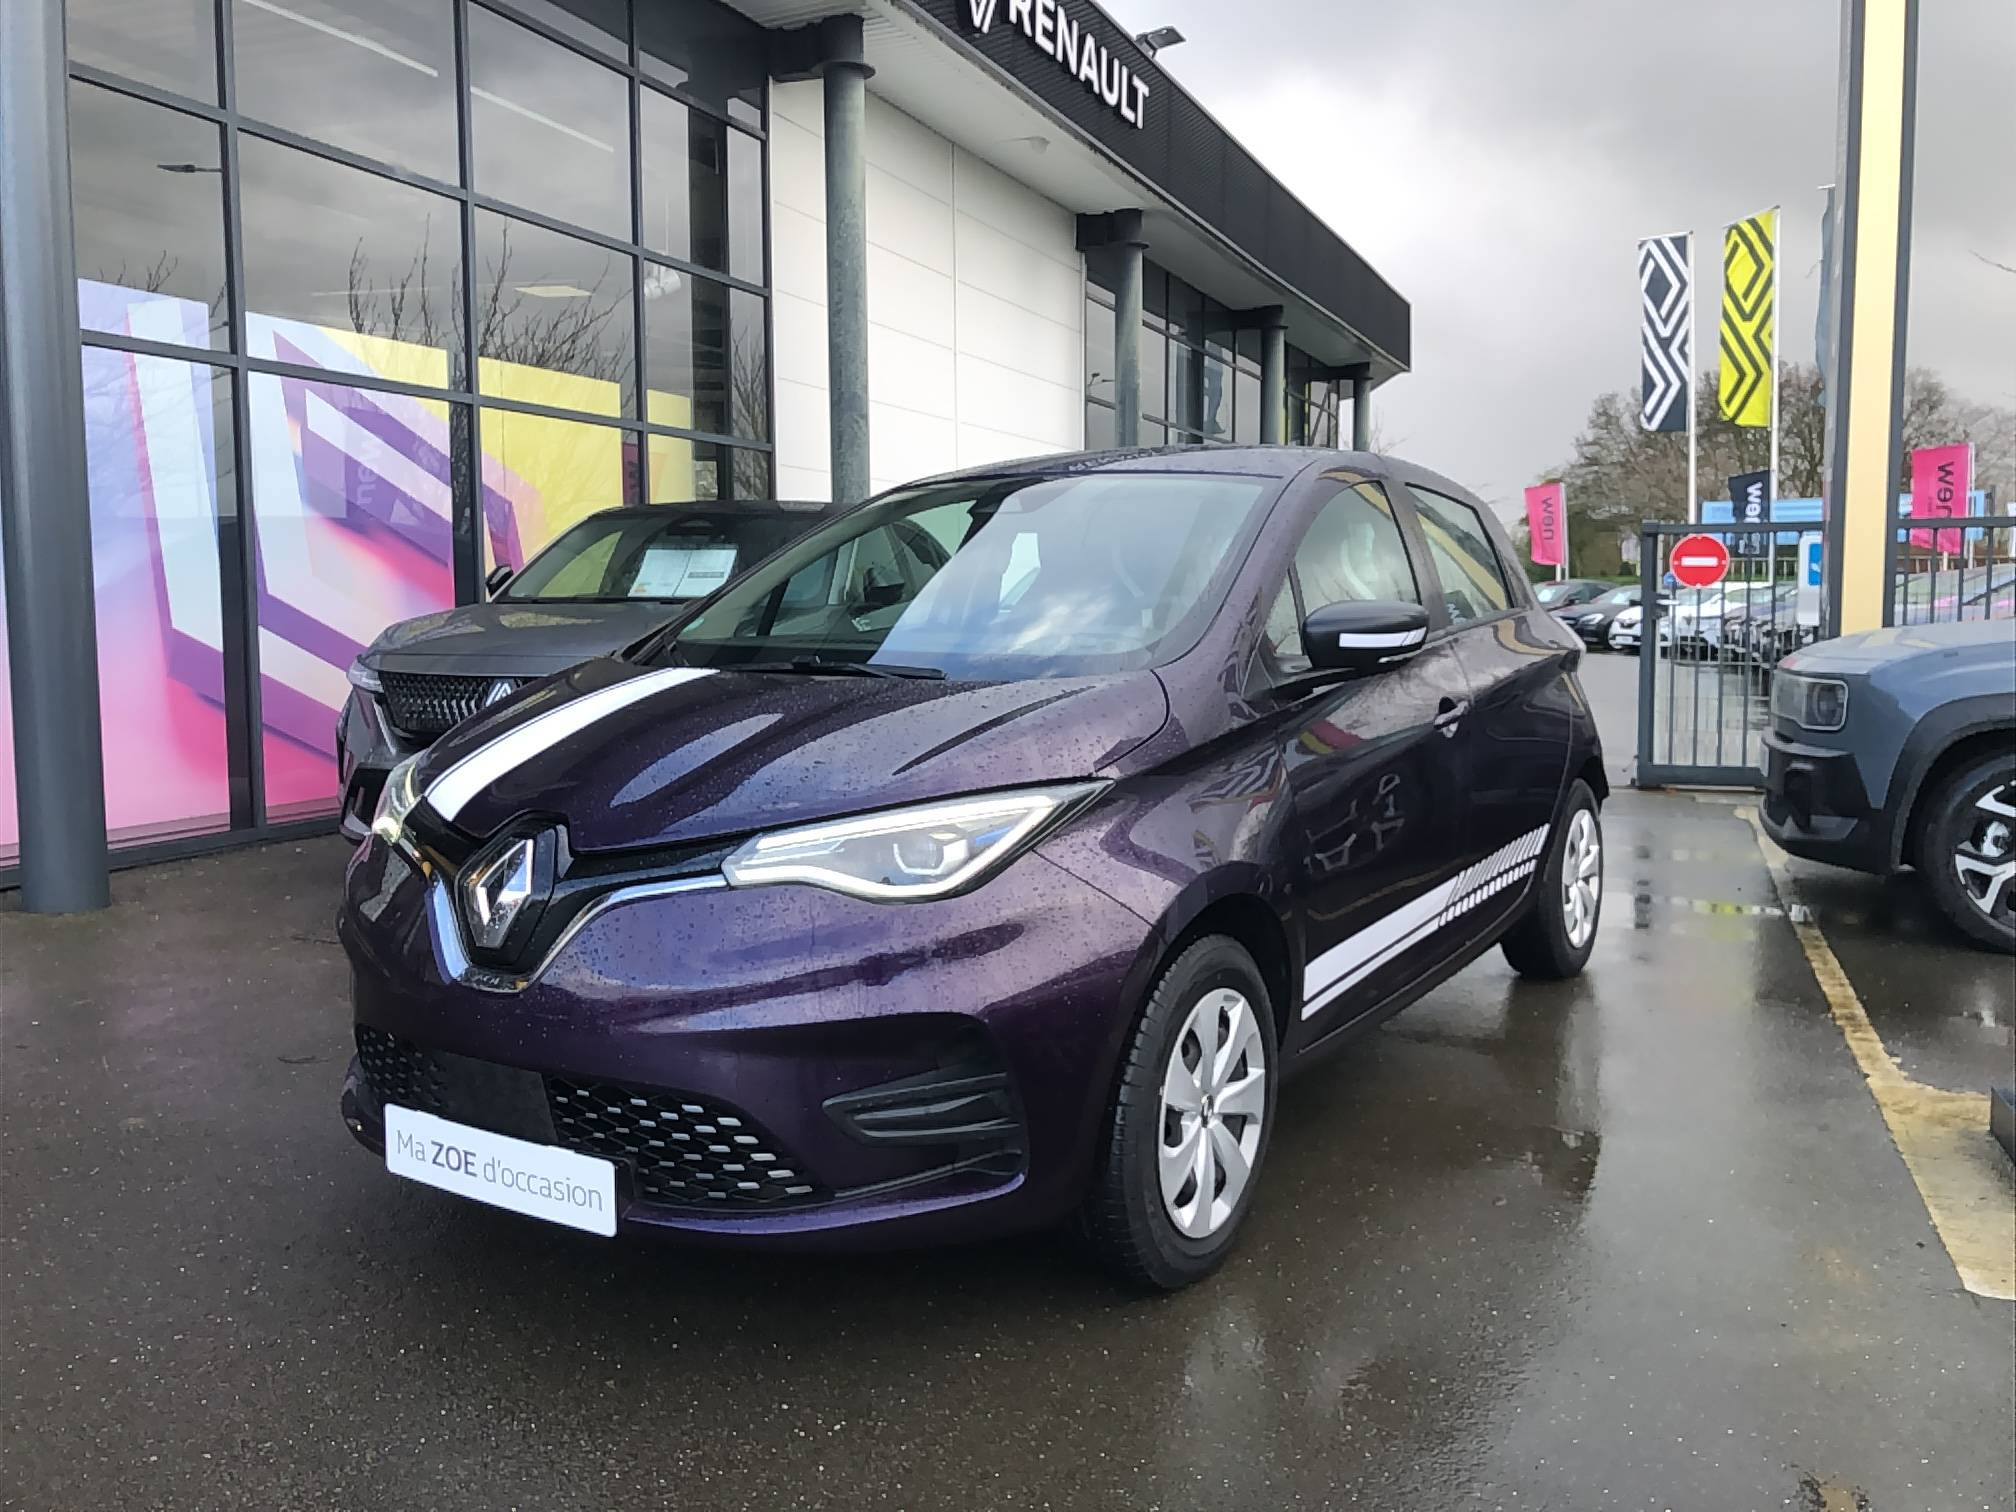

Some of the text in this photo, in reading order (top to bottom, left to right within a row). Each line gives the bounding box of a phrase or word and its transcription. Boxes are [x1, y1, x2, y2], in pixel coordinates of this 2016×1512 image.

[397, 1130, 603, 1212] Ma ZOE d'occasion
